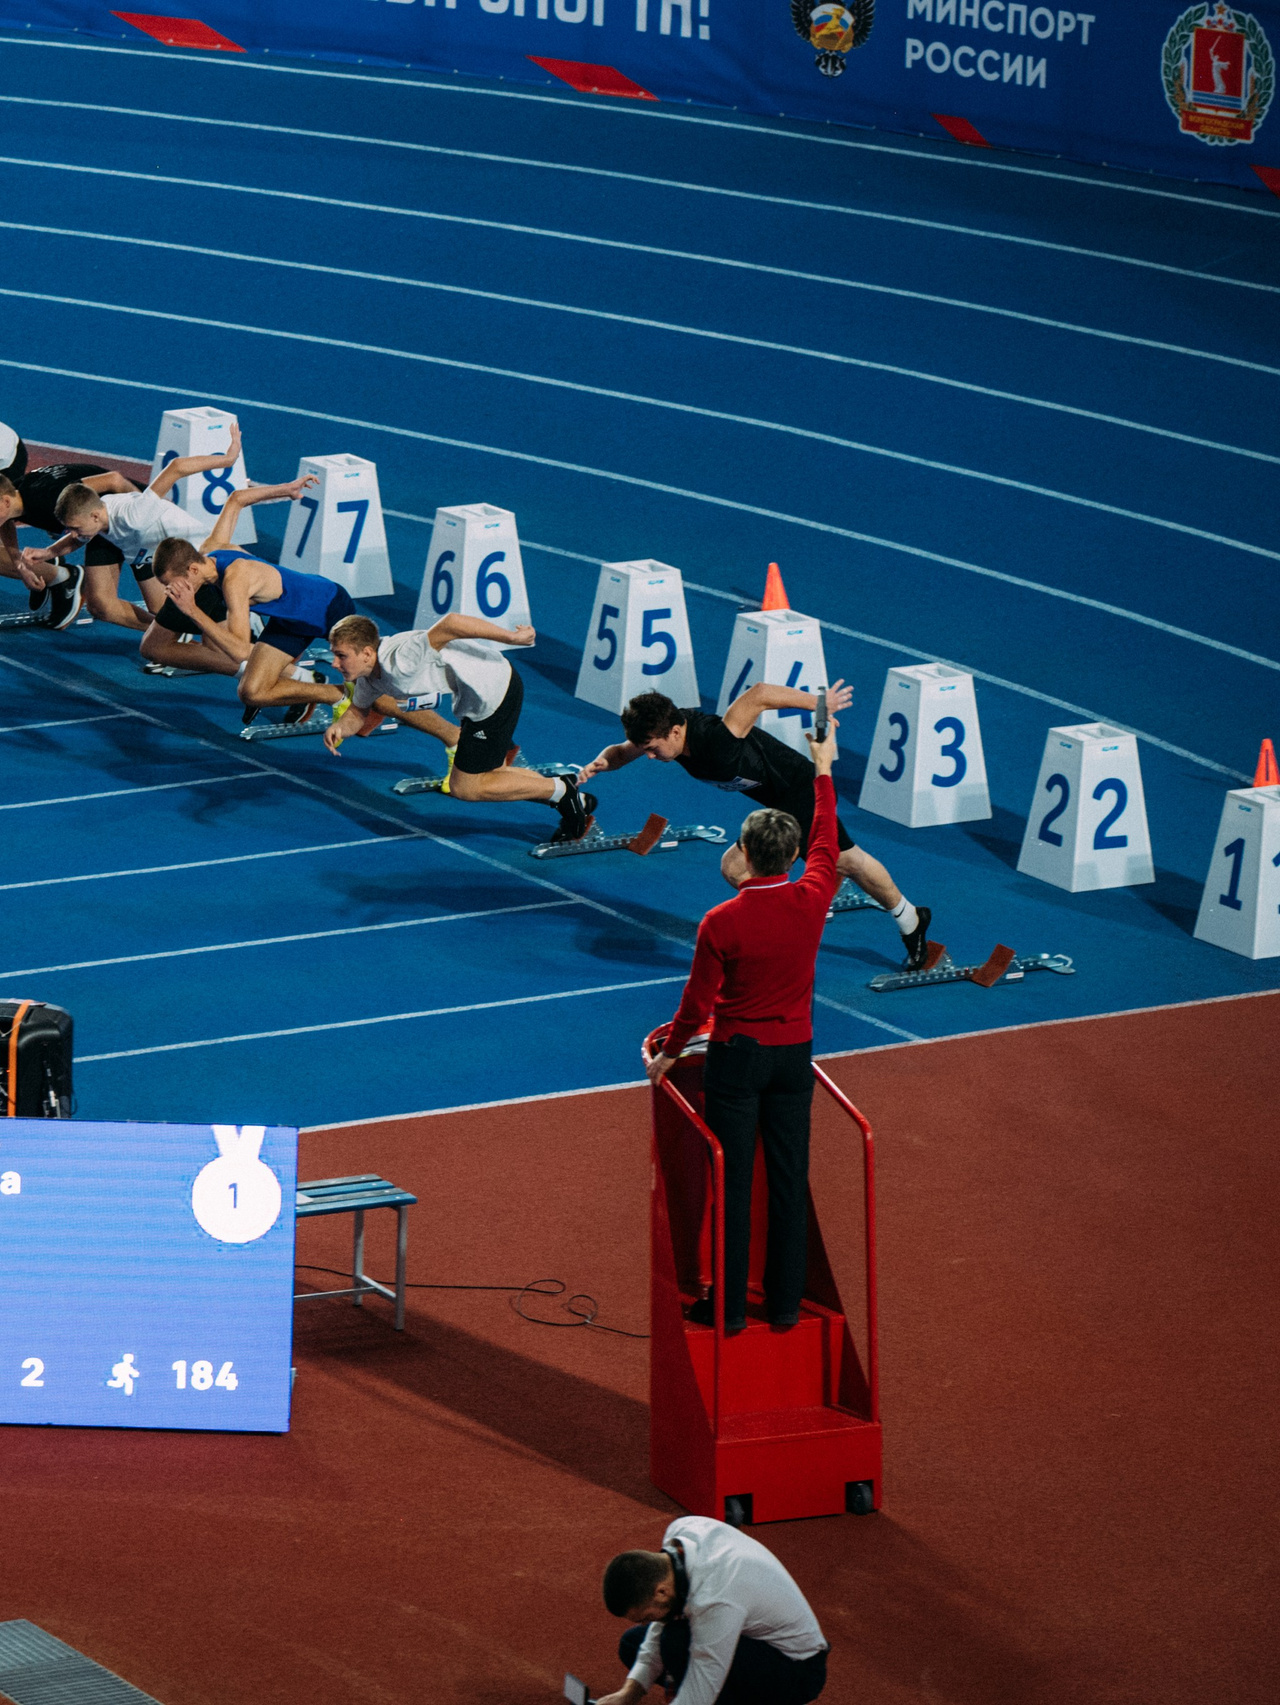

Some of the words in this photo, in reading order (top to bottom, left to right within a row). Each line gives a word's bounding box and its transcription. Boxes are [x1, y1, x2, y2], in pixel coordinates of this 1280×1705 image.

[906, 0, 1096, 45] МИНСПОРТ
[905, 37, 1048, 89] РОССИИ
[202, 452, 236, 516] 8
[296, 495, 320, 559] 7
[336, 499, 370, 564] 7
[431, 550, 456, 616] 6
[475, 551, 511, 618] 6
[593, 603, 620, 672] 5
[641, 607, 677, 676] 5
[878, 711, 910, 783] 3
[931, 716, 967, 788] 3
[1037, 773, 1071, 848] 2
[1092, 777, 1129, 851] 2
[1219, 837, 1246, 912] 1
[228, 1181, 239, 1209] 1
[20, 1357, 45, 1387] 2
[172, 1360, 239, 1391] 184
